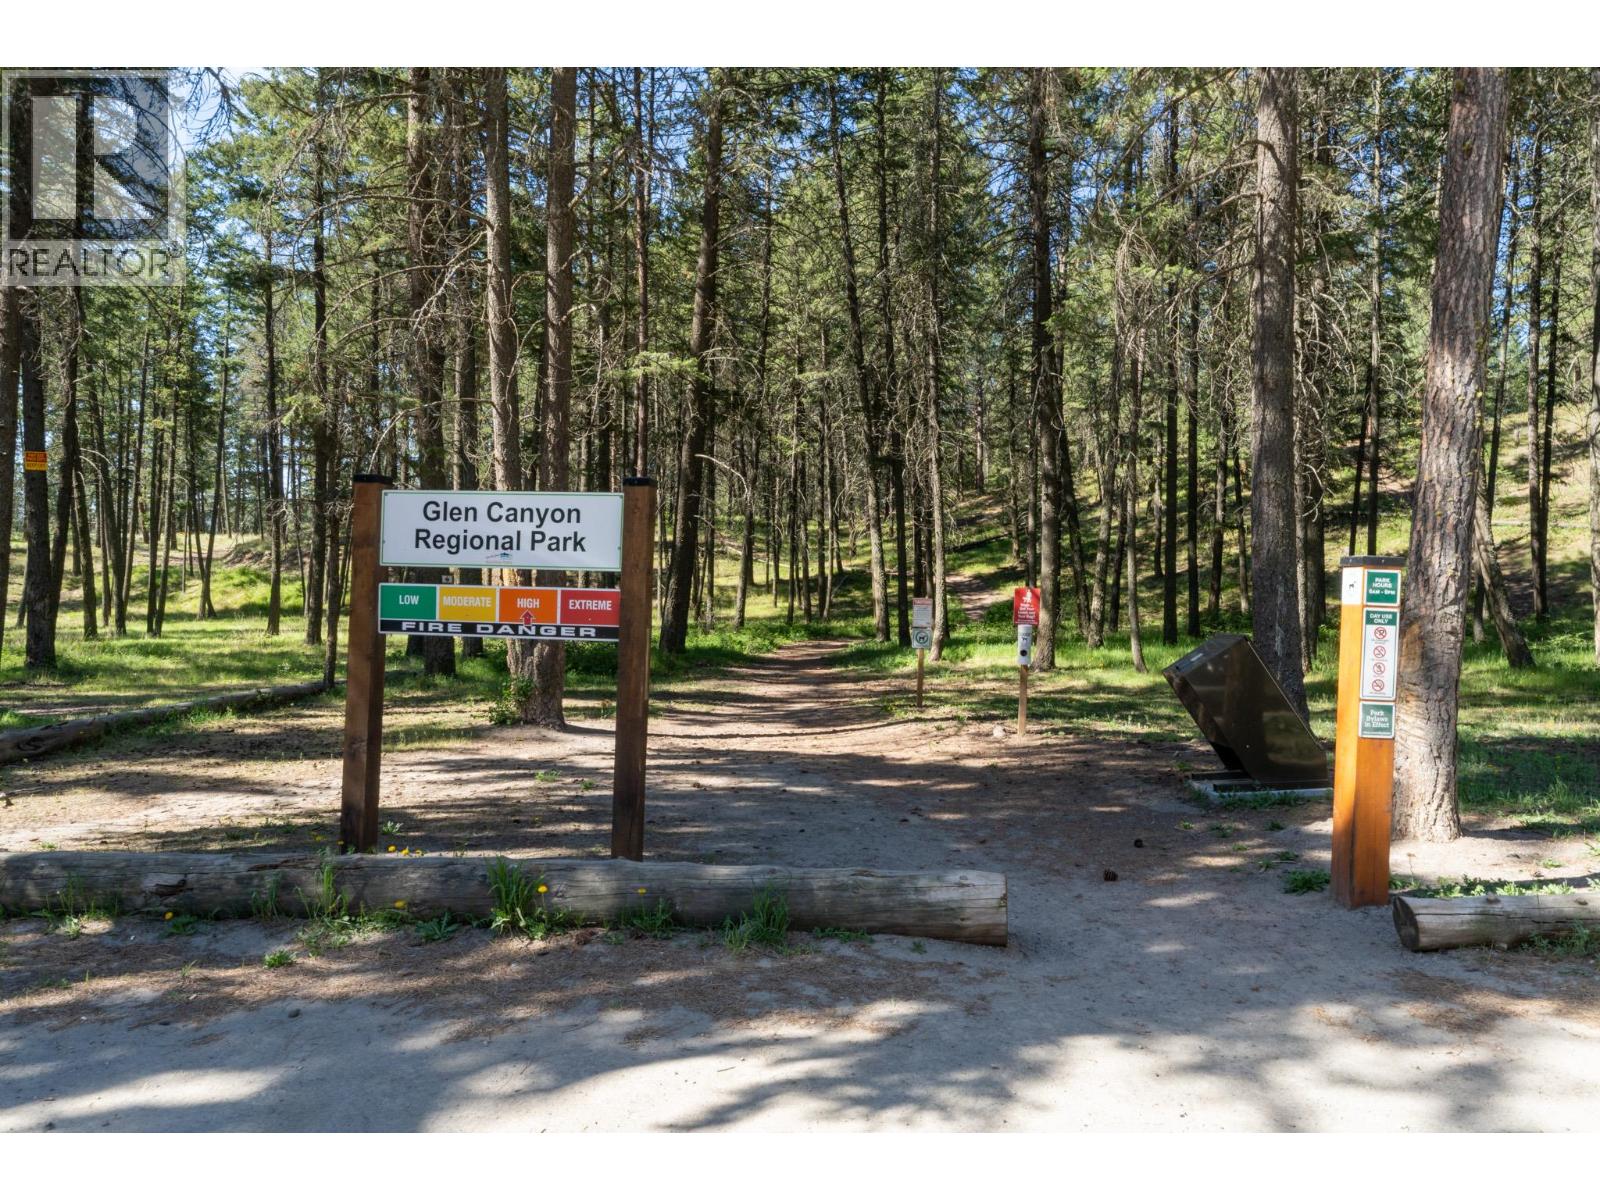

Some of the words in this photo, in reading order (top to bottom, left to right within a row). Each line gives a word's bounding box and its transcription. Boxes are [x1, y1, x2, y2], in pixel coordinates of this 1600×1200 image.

[423, 500, 477, 522] Glen
[487, 501, 581, 528] Canyon
[415, 528, 521, 554] Regional
[531, 531, 587, 552] Park
[399, 594, 419, 605] LOW
[443, 595, 492, 607] MODERATE
[517, 597, 540, 609] HIGH
[569, 599, 612, 611] EXTREME
[401, 621, 462, 634] FIRE
[476, 623, 597, 637] DANGER
